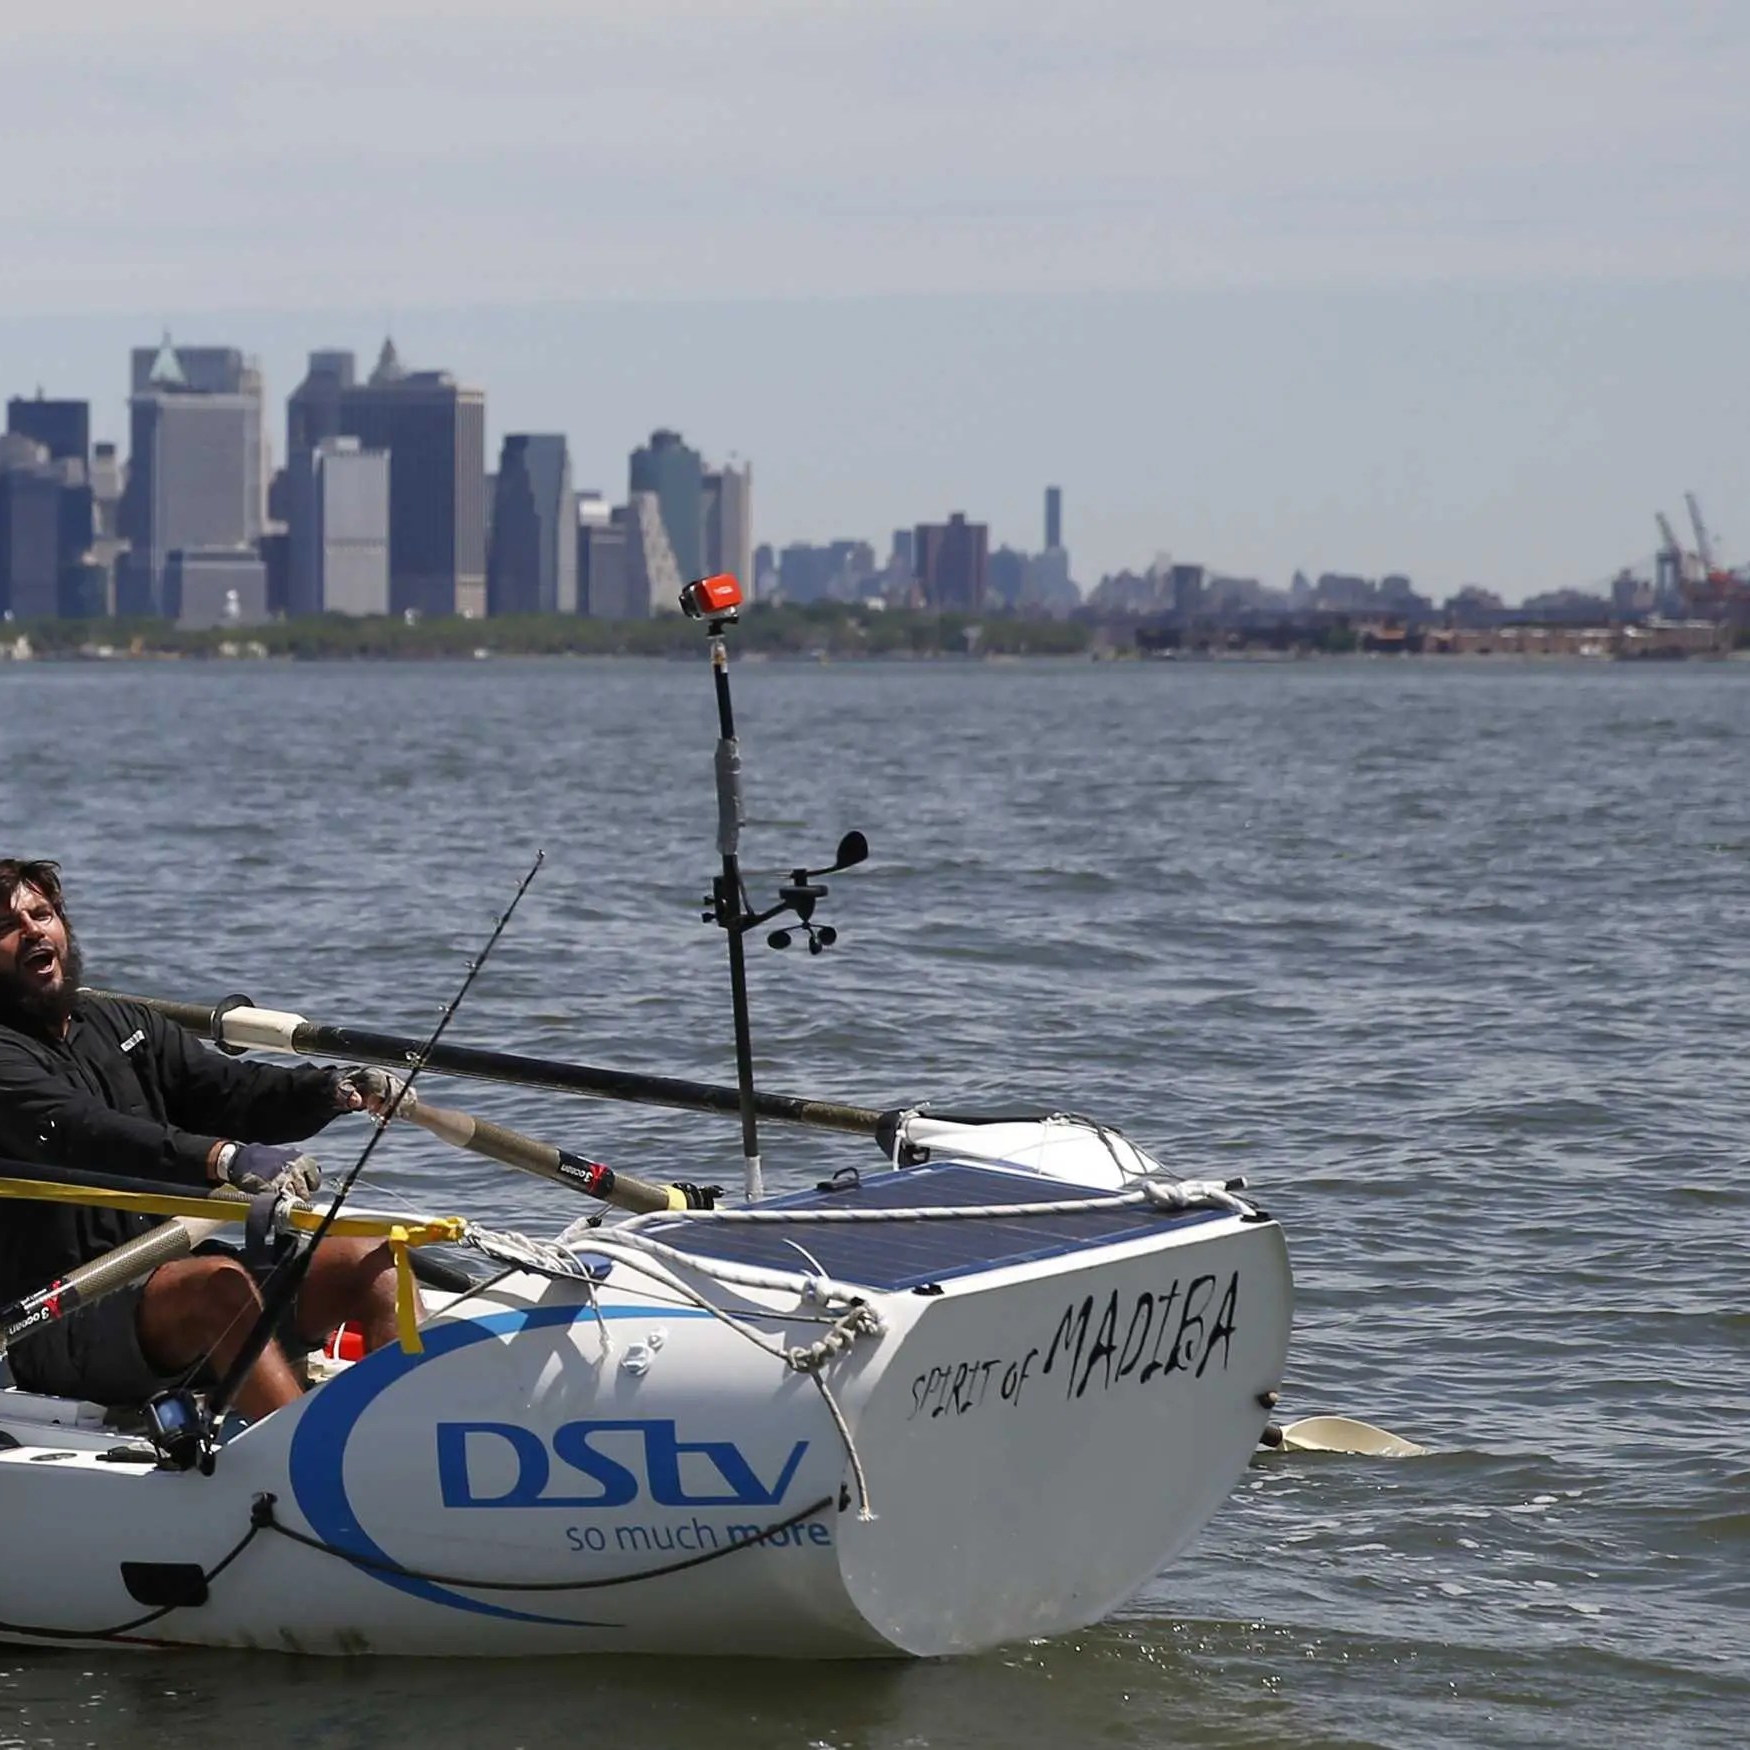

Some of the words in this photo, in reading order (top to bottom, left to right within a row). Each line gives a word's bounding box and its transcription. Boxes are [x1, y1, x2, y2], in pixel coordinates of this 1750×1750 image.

[9, 1312, 41, 1335] ocean
[907, 1359, 1002, 1421] SPIRIT
[1043, 1270, 1237, 1401] MADIBA
[566, 1523, 606, 1551] so
[616, 1517, 718, 1552] much
[727, 1521, 831, 1552] more
